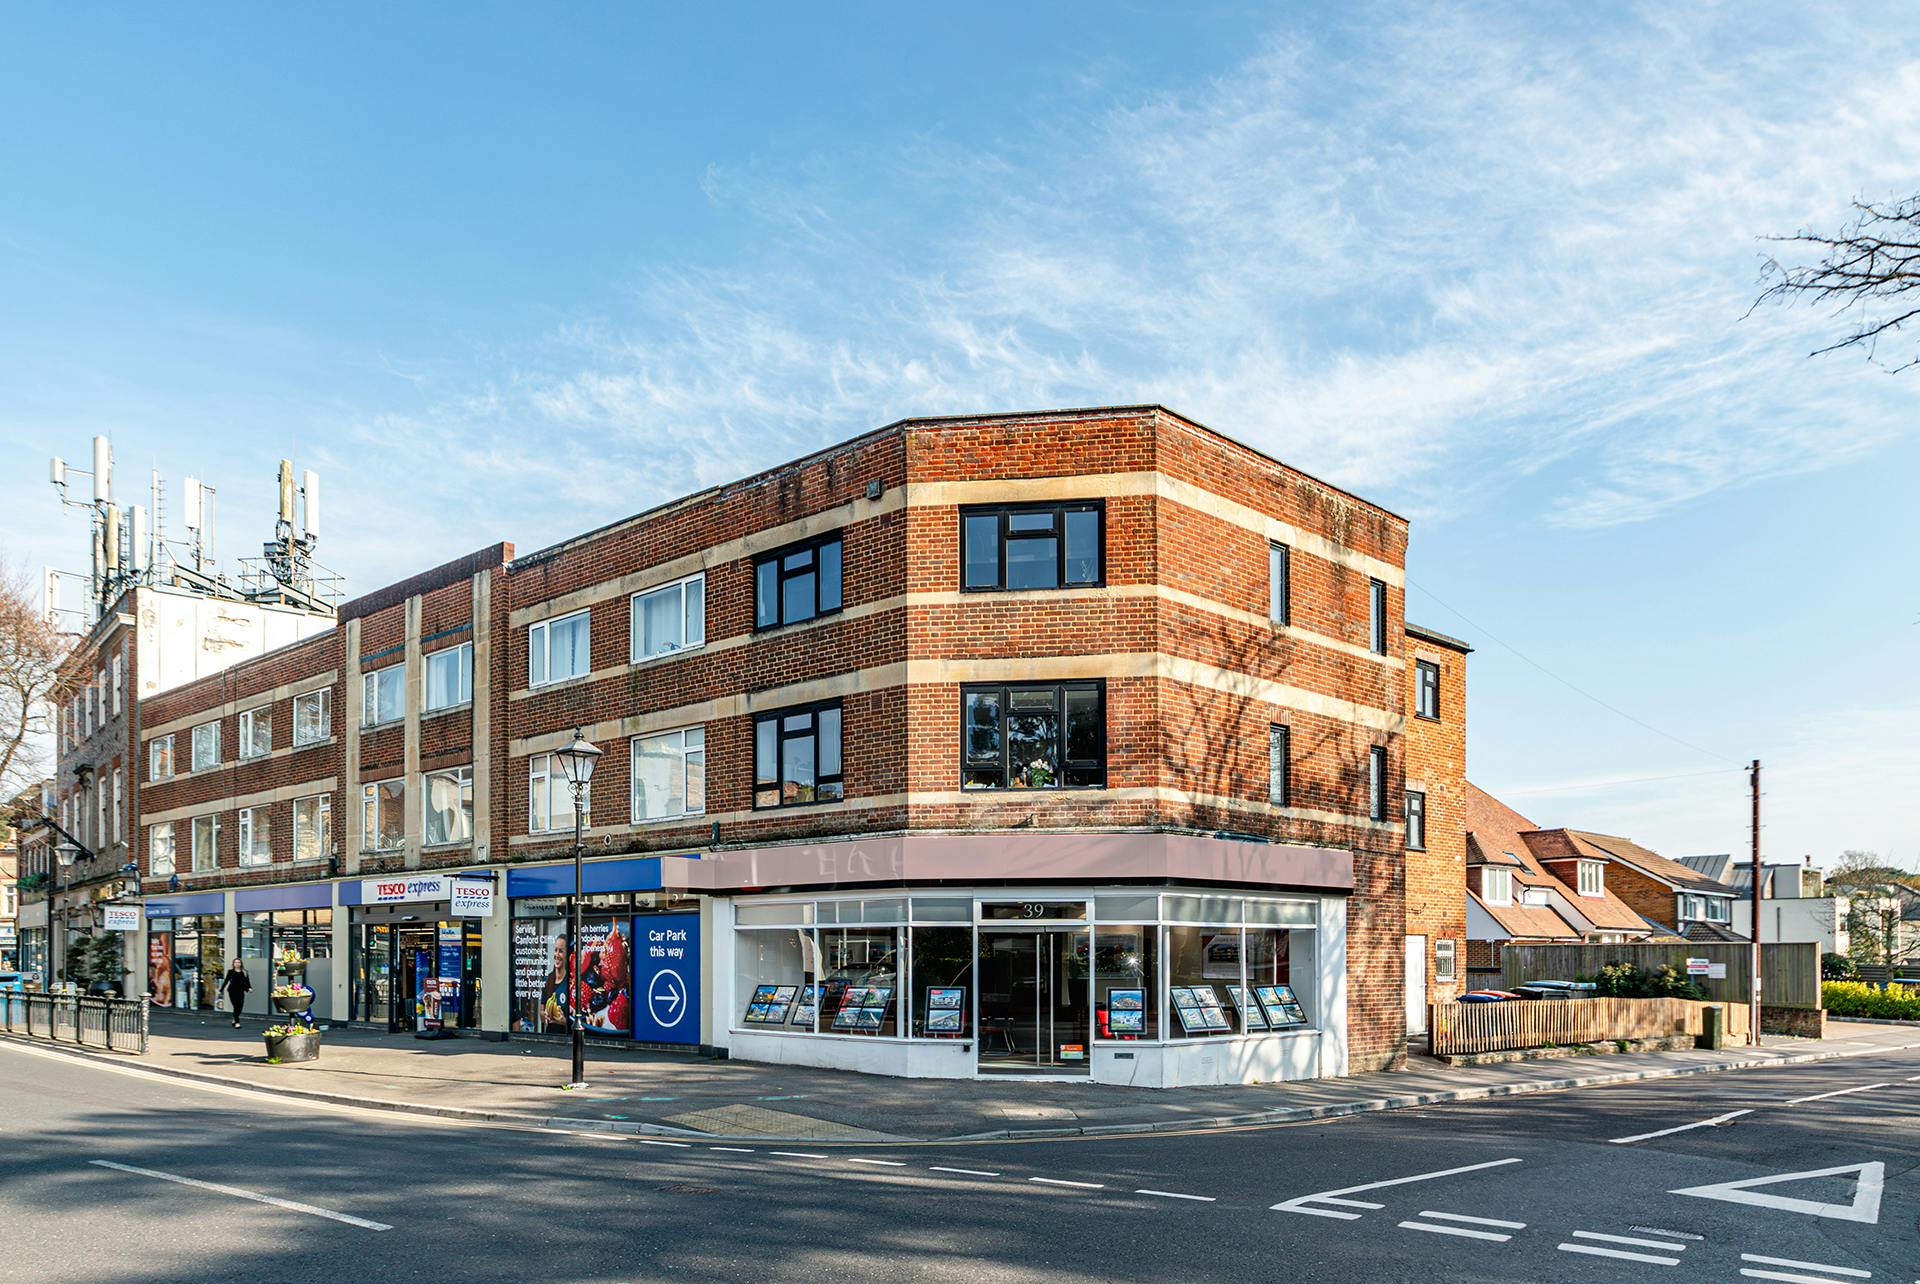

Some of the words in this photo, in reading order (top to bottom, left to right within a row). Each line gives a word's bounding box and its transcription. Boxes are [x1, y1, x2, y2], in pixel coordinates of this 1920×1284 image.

[377, 883, 405, 895] TESCO
[407, 881, 440, 896] express
[456, 887, 490, 896] TESCO
[456, 899, 490, 909] express
[1023, 903, 1044, 918] 39
[515, 925, 536, 935] Serving
[589, 924, 609, 933] berries
[515, 935, 539, 945] Canford
[649, 929, 665, 941] Car
[666, 929, 687, 941] Park
[650, 945, 665, 957] this
[667, 948, 684, 960] way
[515, 968, 526, 976] and
[527, 968, 544, 979] planet
[515, 978, 528, 988] little
[529, 978, 546, 988] better
[515, 990, 531, 1000] every
[532, 989, 542, 1000] day
